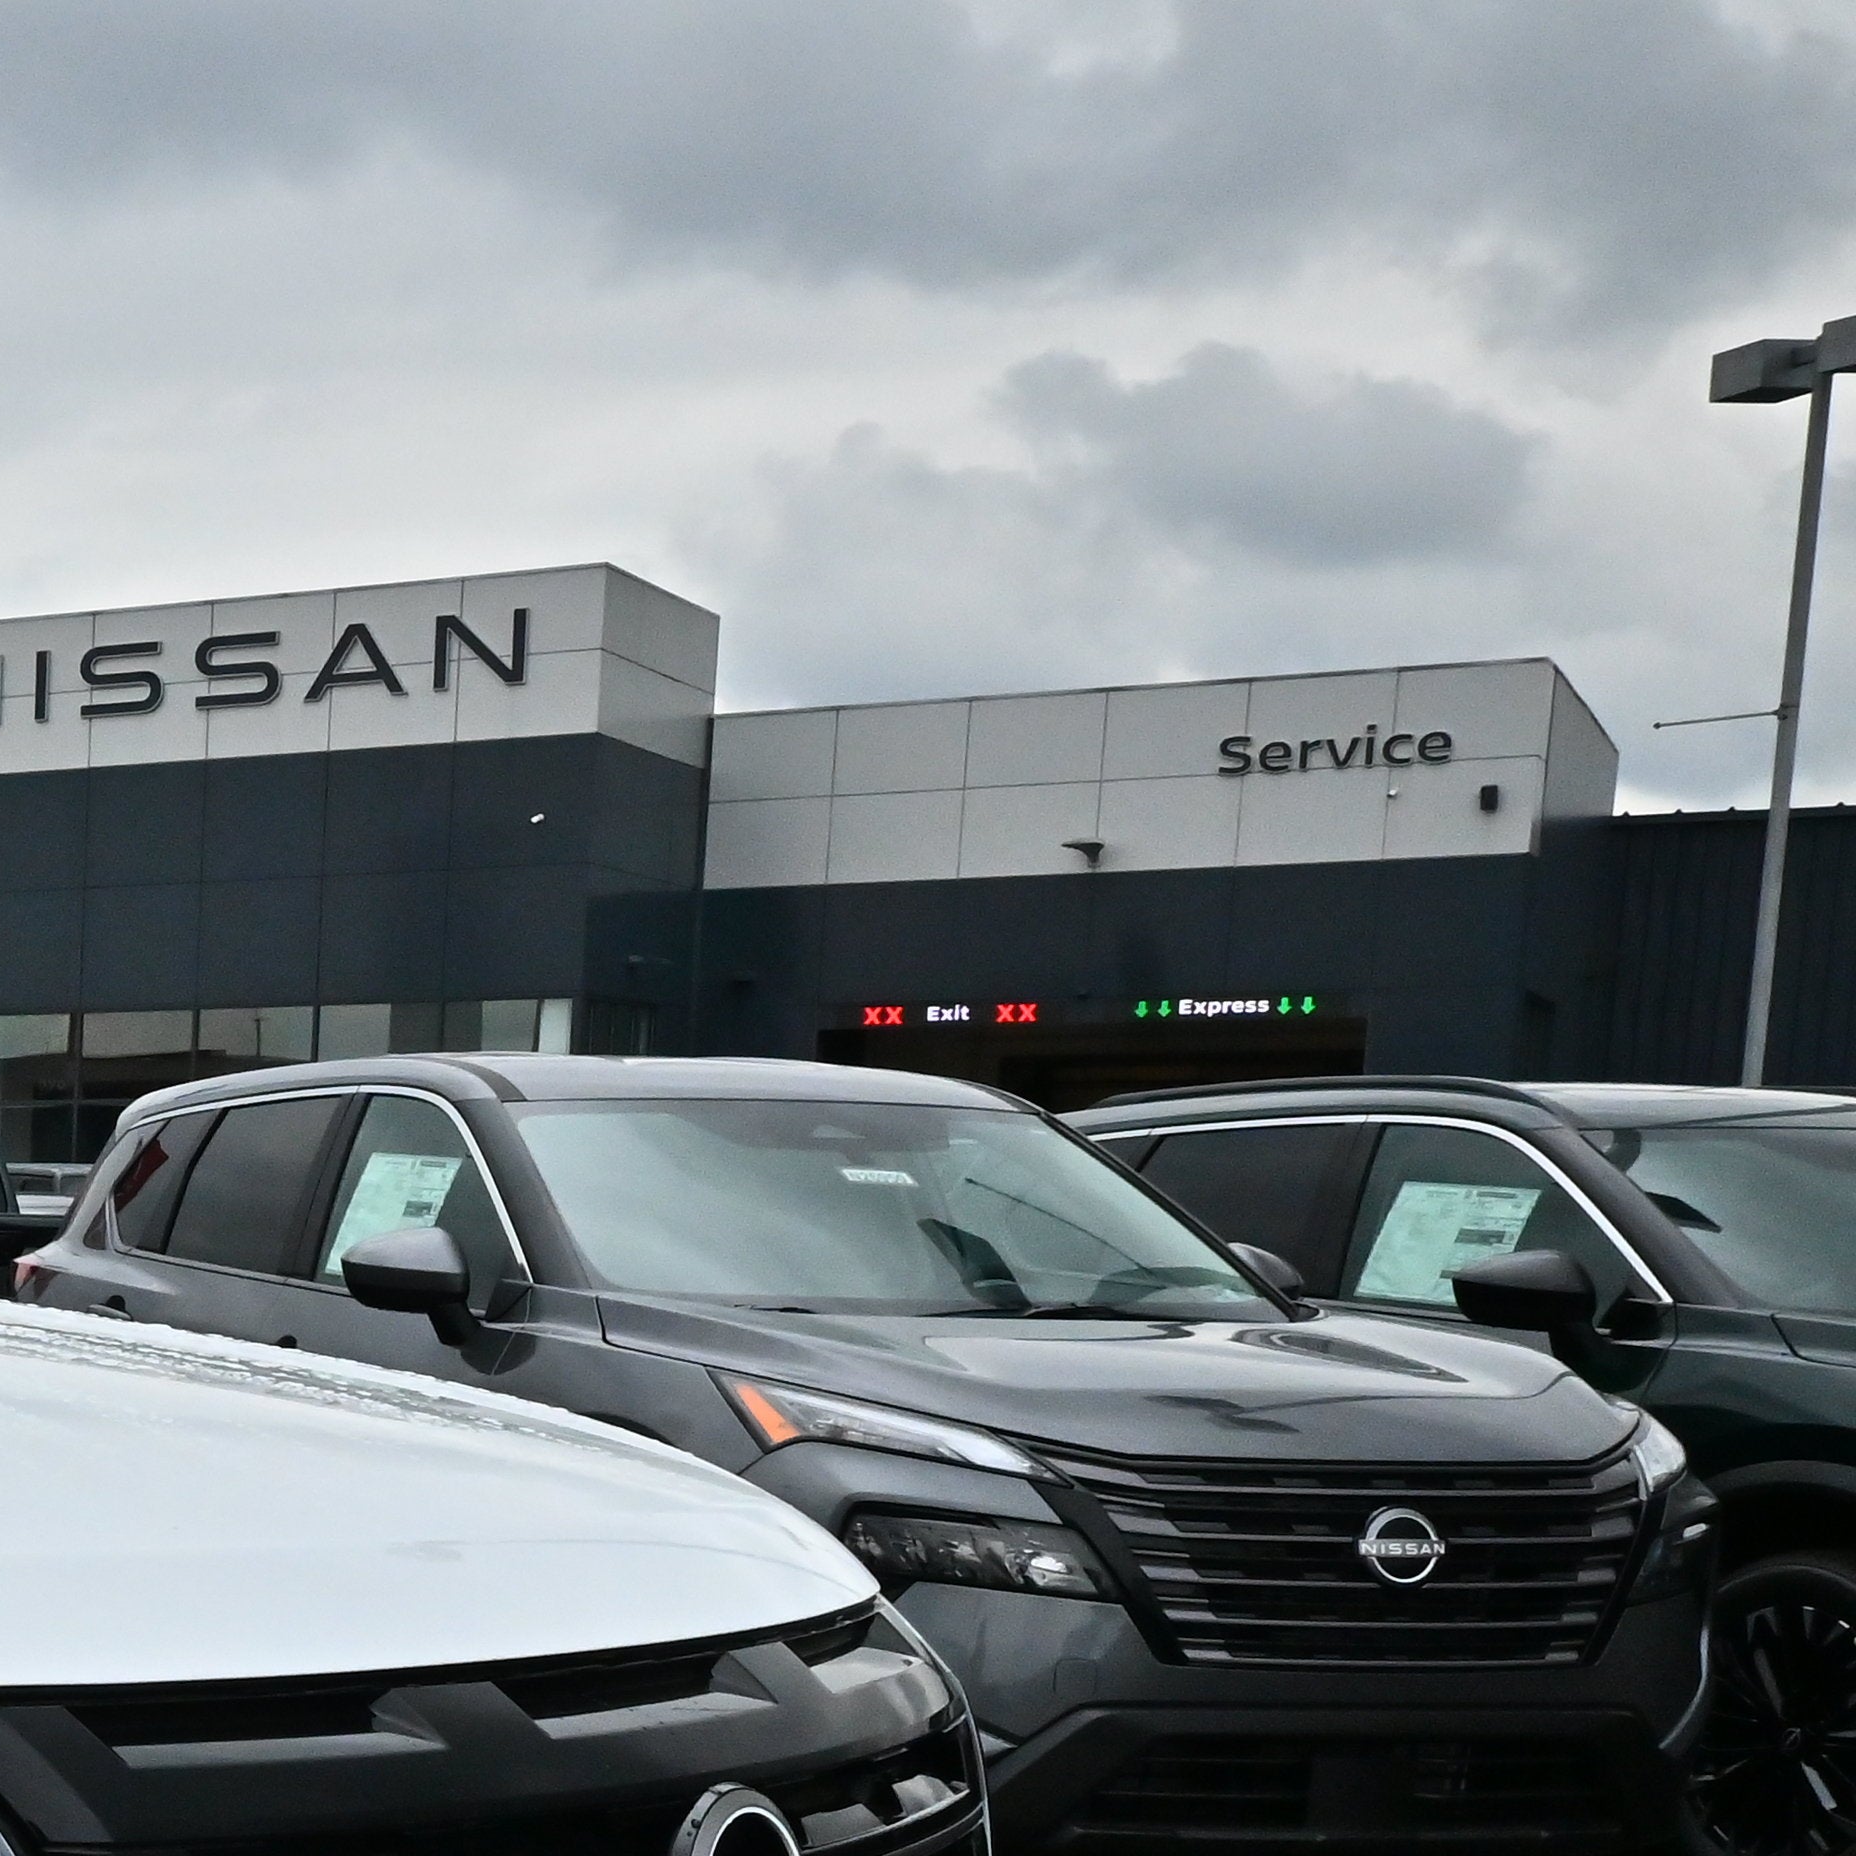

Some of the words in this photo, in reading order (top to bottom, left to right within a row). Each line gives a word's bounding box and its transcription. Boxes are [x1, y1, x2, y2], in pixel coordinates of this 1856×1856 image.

[1218, 724, 1453, 775] Service
[926, 1004, 971, 1022] Exit
[1178, 999, 1270, 1018] Express
[1361, 1543, 1446, 1555] NISSAN
